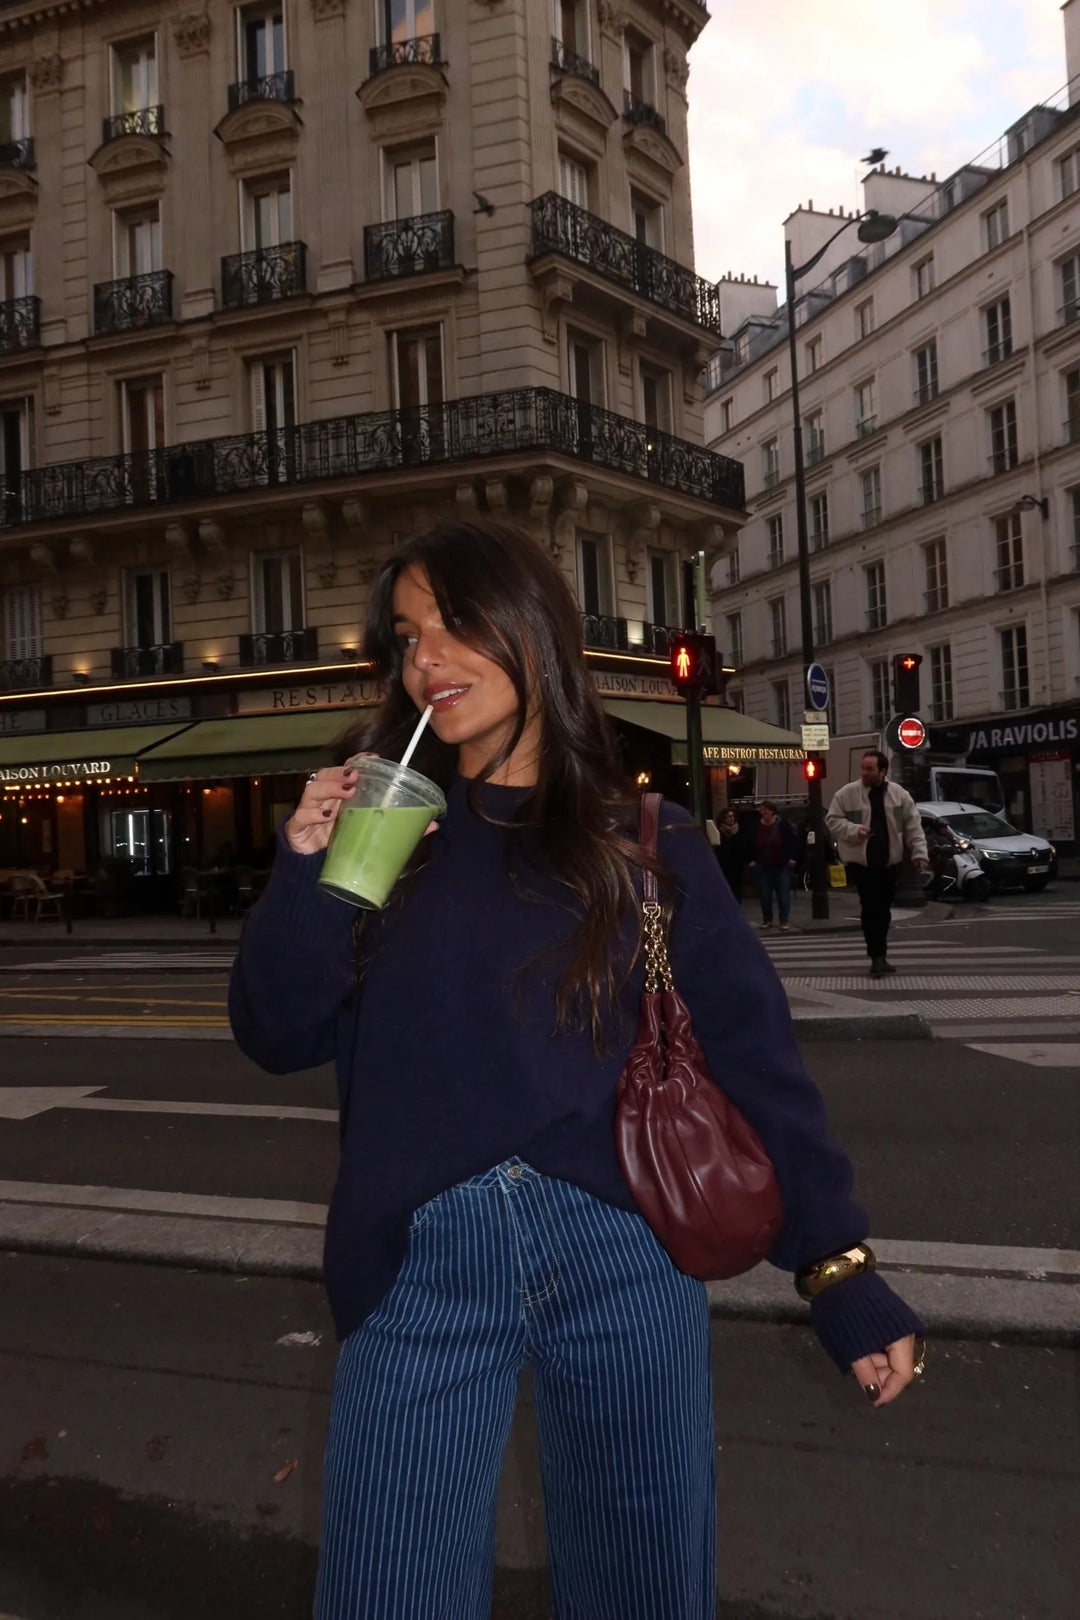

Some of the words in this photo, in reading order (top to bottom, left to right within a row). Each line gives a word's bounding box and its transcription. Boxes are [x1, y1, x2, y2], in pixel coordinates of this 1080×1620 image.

[101, 701, 178, 720] GLACES
[991, 719, 1077, 747] RAVIOLIS
[721, 747, 757, 759] BISTROT
[42, 762, 111, 777] LOUVARD
